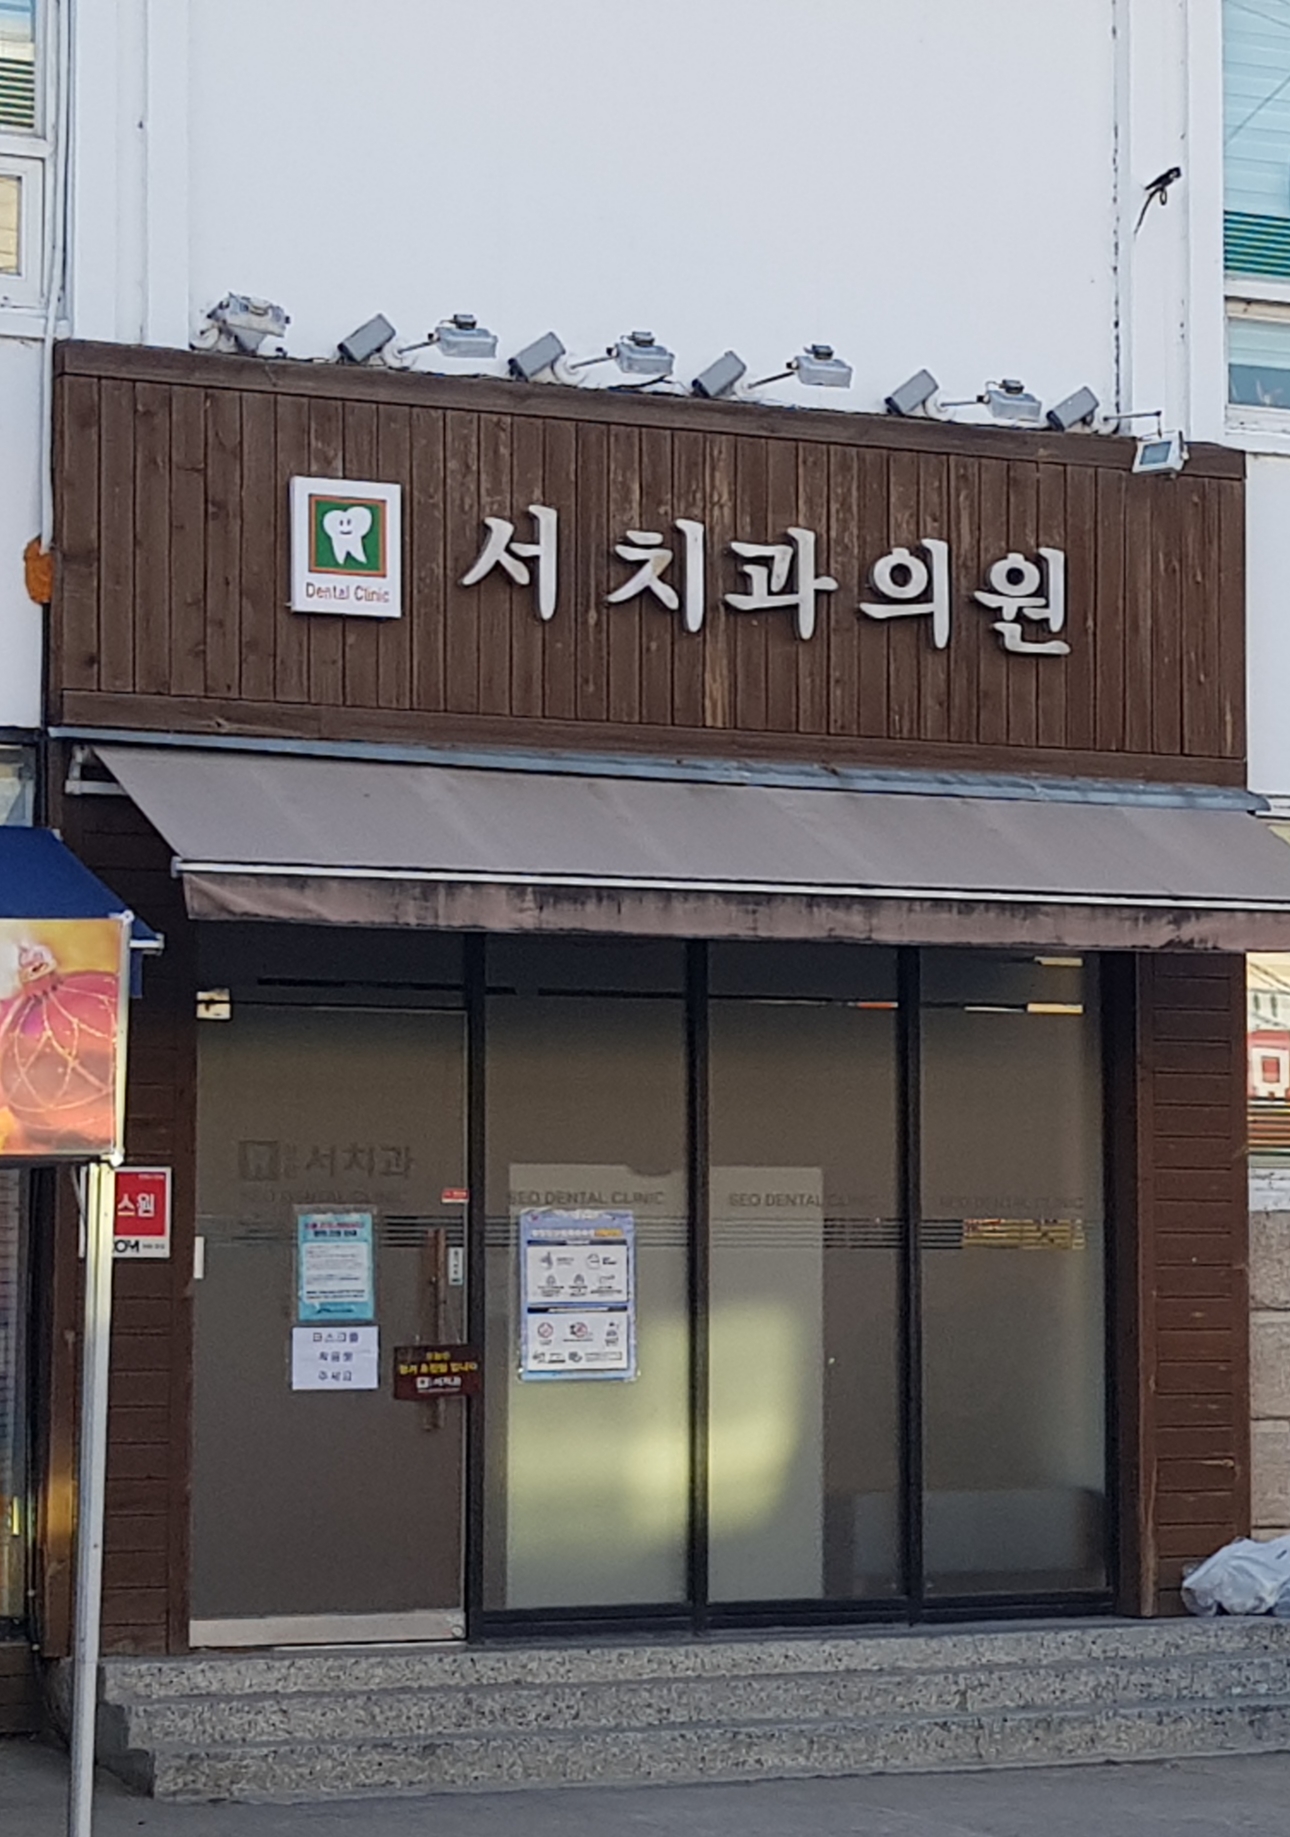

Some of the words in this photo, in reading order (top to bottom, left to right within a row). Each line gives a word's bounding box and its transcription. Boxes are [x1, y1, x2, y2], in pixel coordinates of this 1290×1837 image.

[461, 503, 1071, 655] 서치과의원
[305, 582, 350, 600] Dental
[354, 585, 390, 603] Clinic
[305, 1143, 415, 1179] 서치과
[117, 1193, 155, 1218] 스원
[544, 1190, 605, 1205] DENTAL
[611, 1190, 665, 1206] CLINIC
[728, 1192, 761, 1206] SEO
